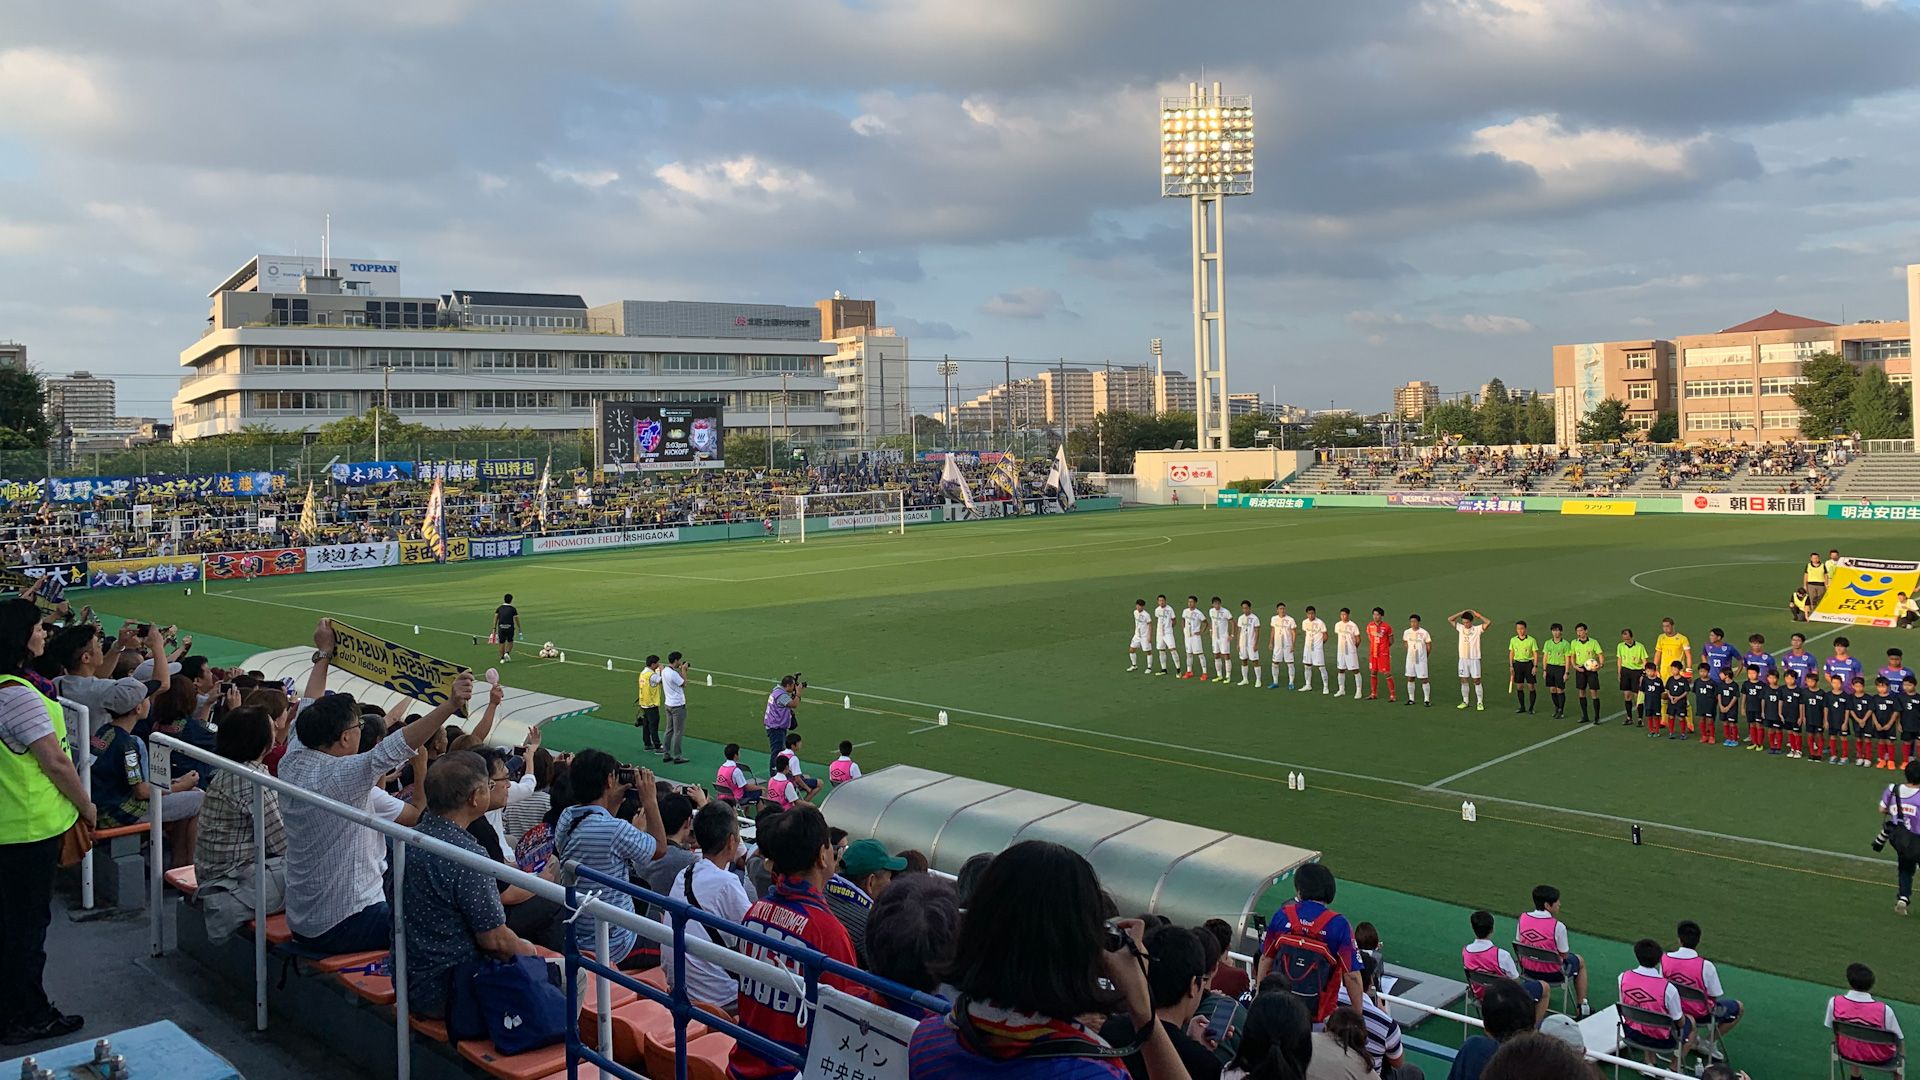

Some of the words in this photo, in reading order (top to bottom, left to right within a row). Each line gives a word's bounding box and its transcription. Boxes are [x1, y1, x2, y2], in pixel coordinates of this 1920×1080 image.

[350, 263, 398, 273] TOPPAN
[664, 448, 690, 456] KICKOFF
[480, 461, 535, 476] 吉田将也
[53, 479, 130, 500] 飯野七聖
[217, 475, 254, 493] 佐藤
[1249, 498, 1304, 508] 明治安田生命
[1402, 495, 1431, 503] RESPECT
[1729, 497, 1805, 511] 朝日新聞
[599, 535, 622, 544] FIELD
[623, 531, 675, 542] NISHIGAOKA
[317, 547, 377, 563] 渡辺広大
[404, 541, 466, 561] 岩田也
[92, 562, 198, 587] 久木田紳吾
[770, 905, 809, 935] DOROMPA
[838, 1035, 888, 1067] メイン
